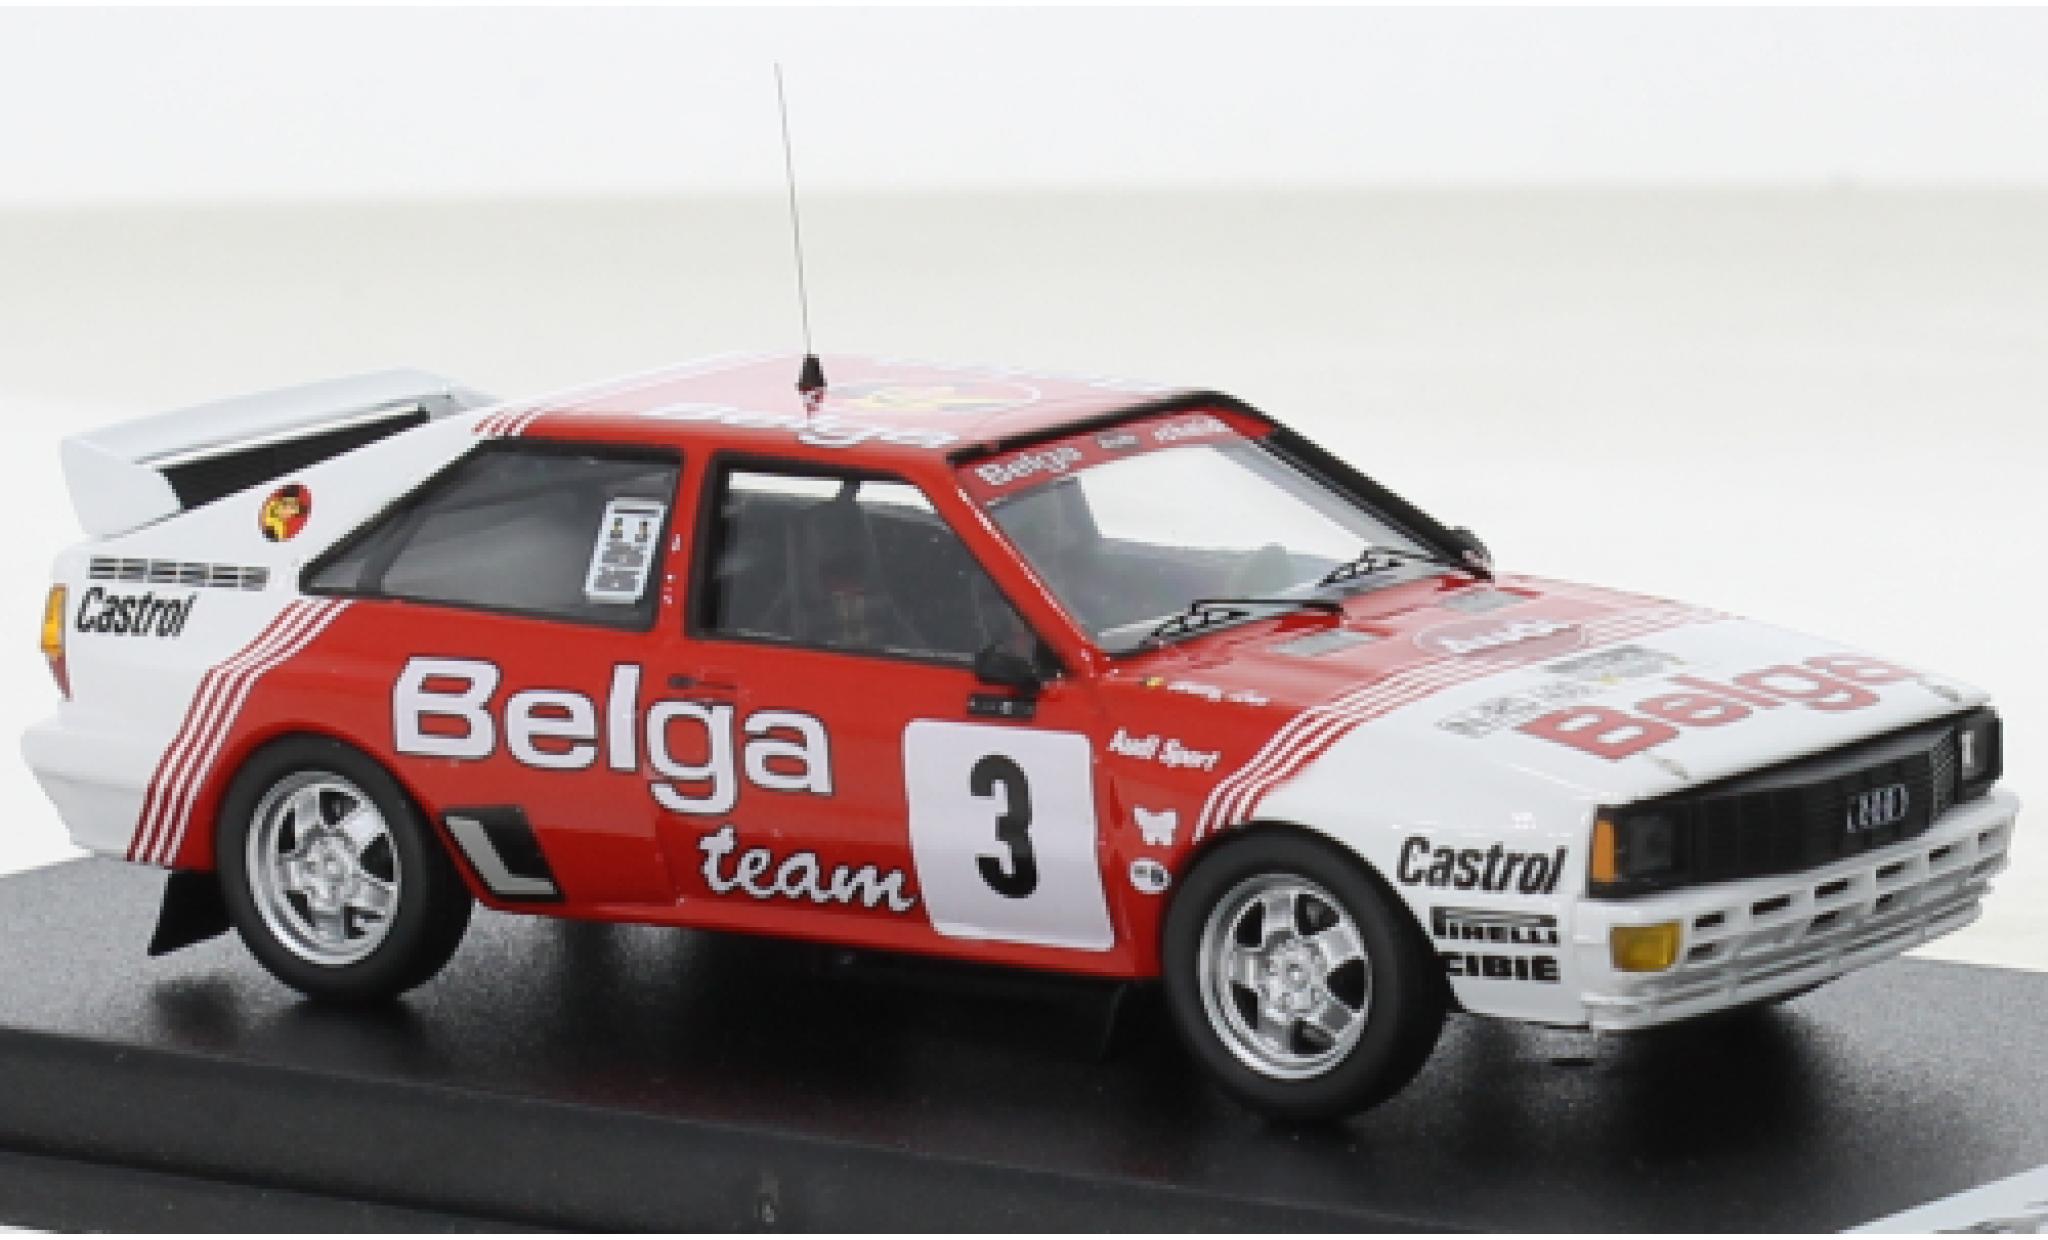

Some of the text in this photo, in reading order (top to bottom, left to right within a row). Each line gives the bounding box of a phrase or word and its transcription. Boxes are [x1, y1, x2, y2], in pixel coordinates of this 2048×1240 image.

[975, 447, 1082, 486] Belga
[76, 586, 200, 640] Castrol
[392, 655, 835, 815] Belga
[1512, 653, 1915, 763] Belga
[1107, 728, 1221, 772] Audi Sport
[969, 753, 1038, 899] 3
[697, 824, 915, 912] team
[1396, 834, 1569, 894] Castrol
[1429, 906, 1561, 947] PIRELLI
